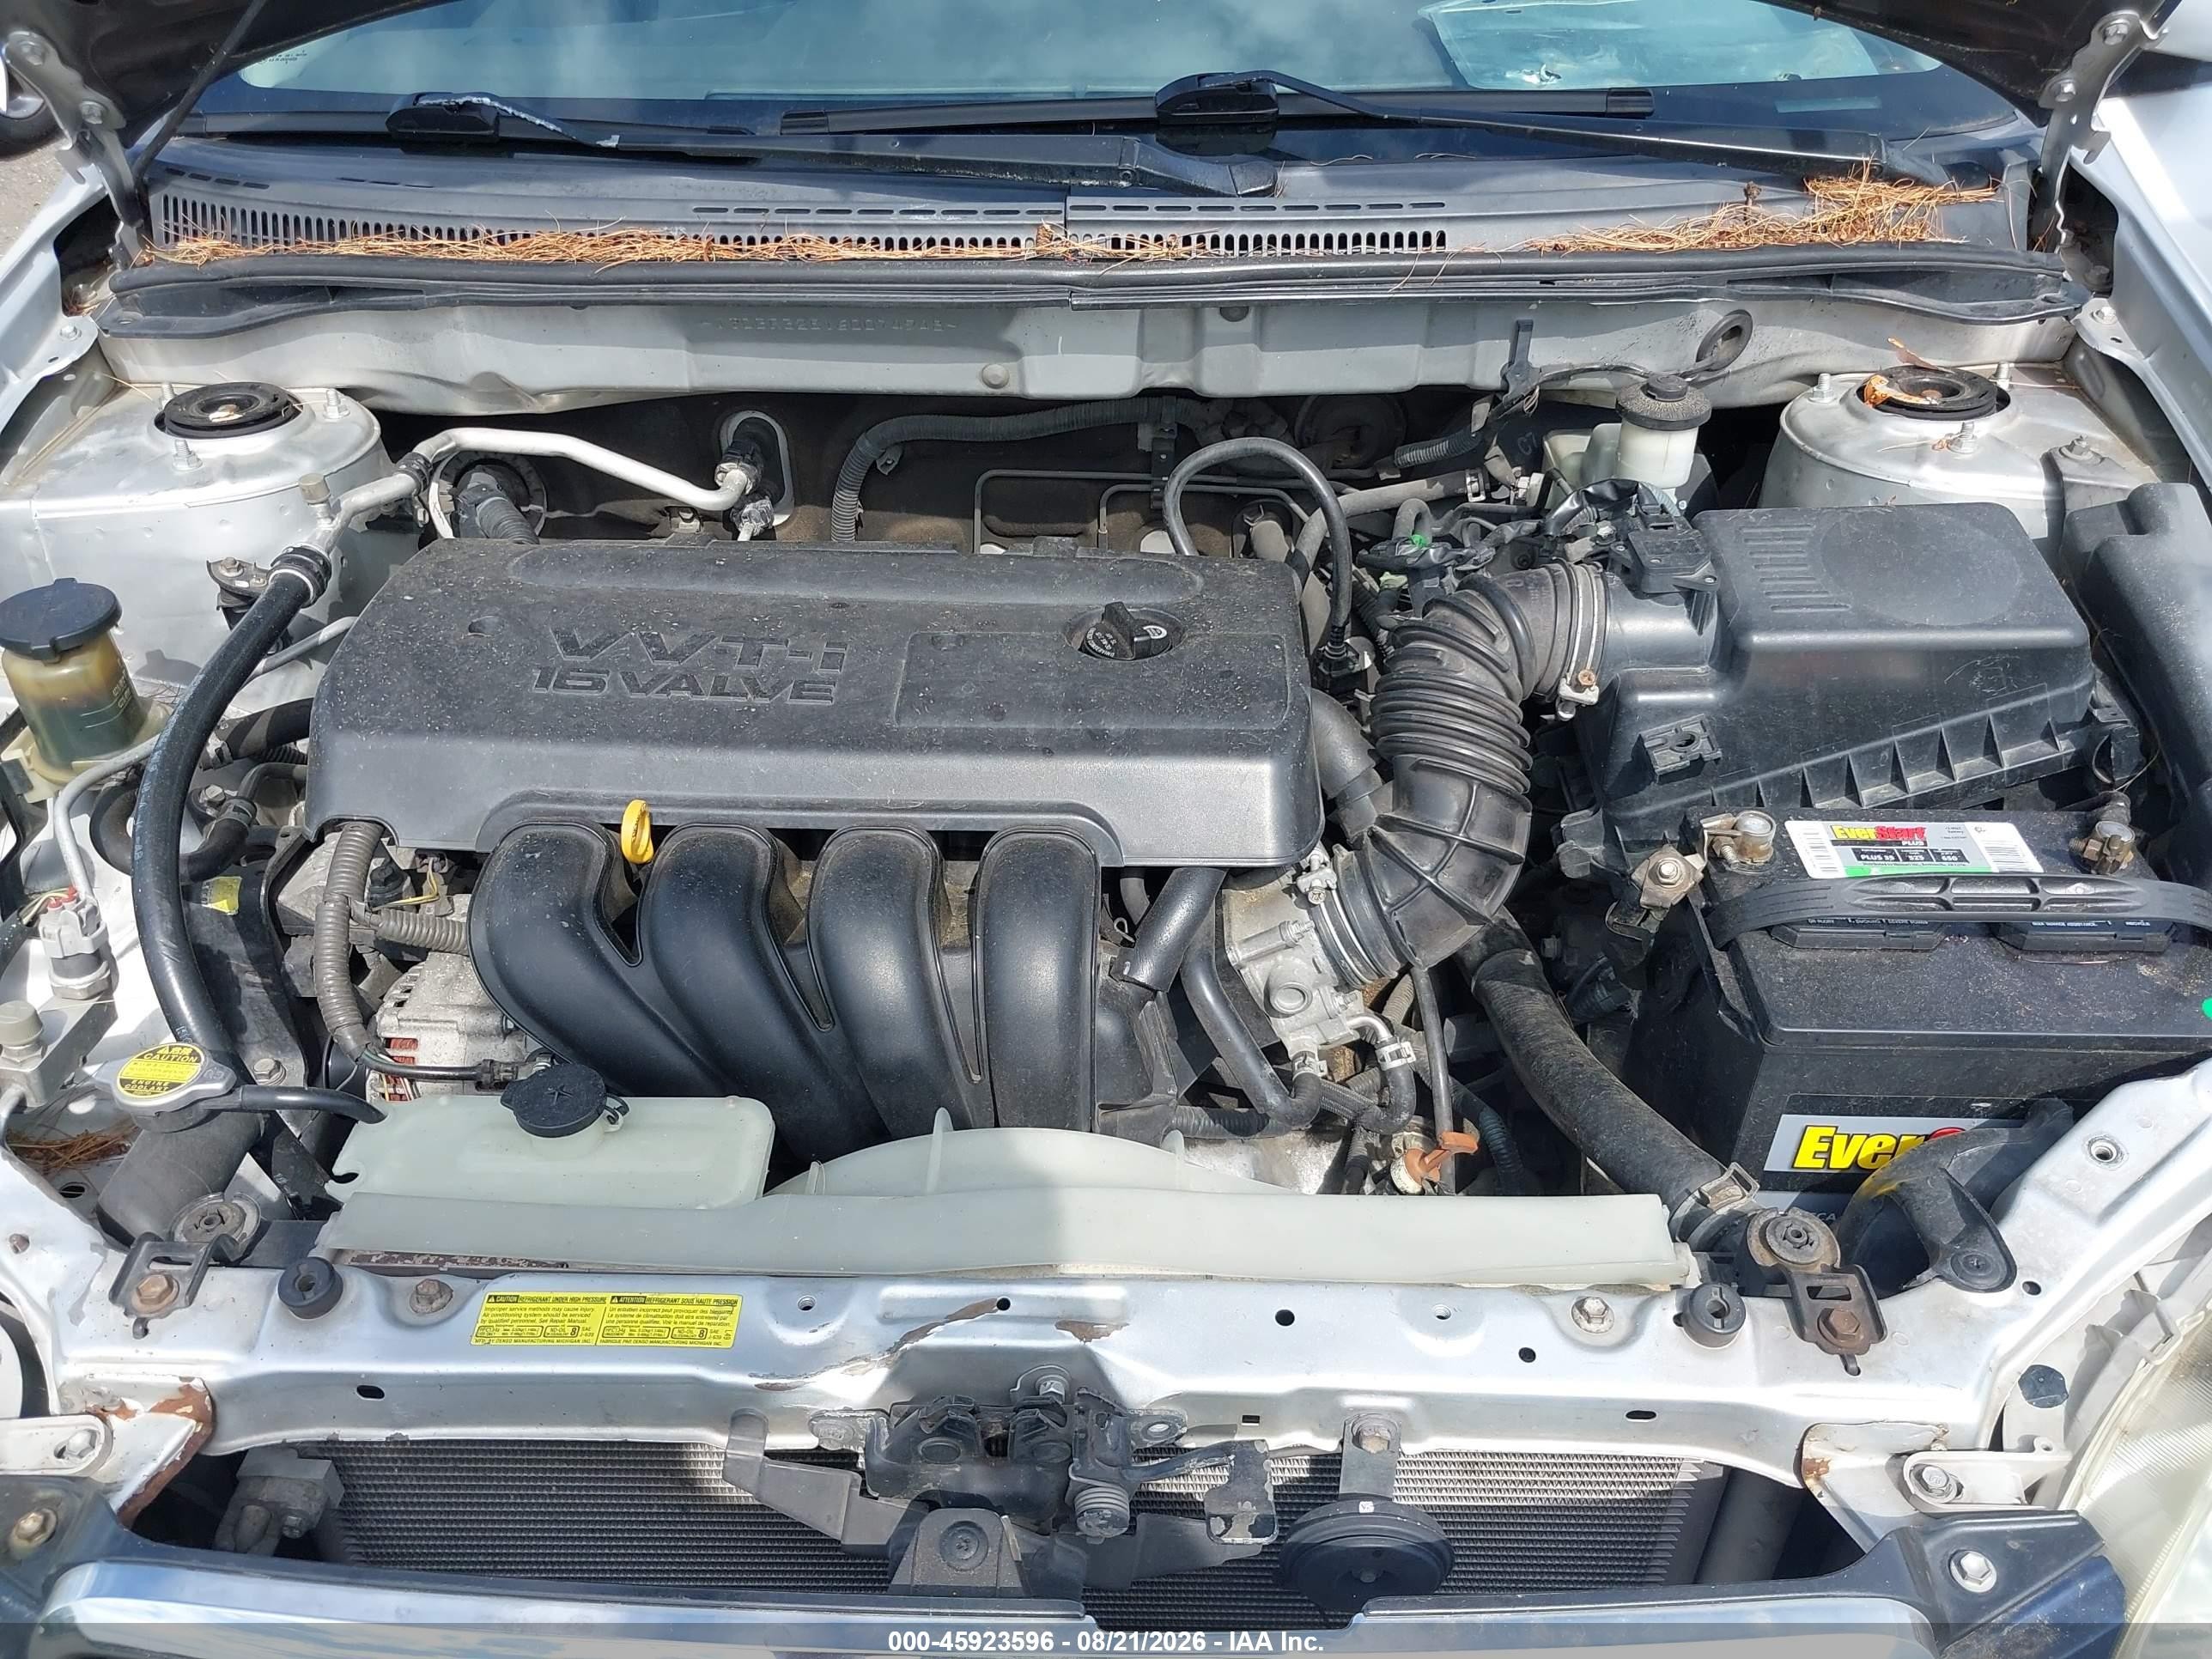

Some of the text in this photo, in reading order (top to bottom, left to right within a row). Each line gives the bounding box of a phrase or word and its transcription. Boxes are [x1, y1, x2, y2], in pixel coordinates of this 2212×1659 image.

[532, 666, 837, 705] 16 VALVE
[1830, 824, 1926, 840] EverStart
[143, 1053, 198, 1062] CAUTION
[569, 1327, 577, 1336] 8
[698, 1329, 705, 1338] 8
